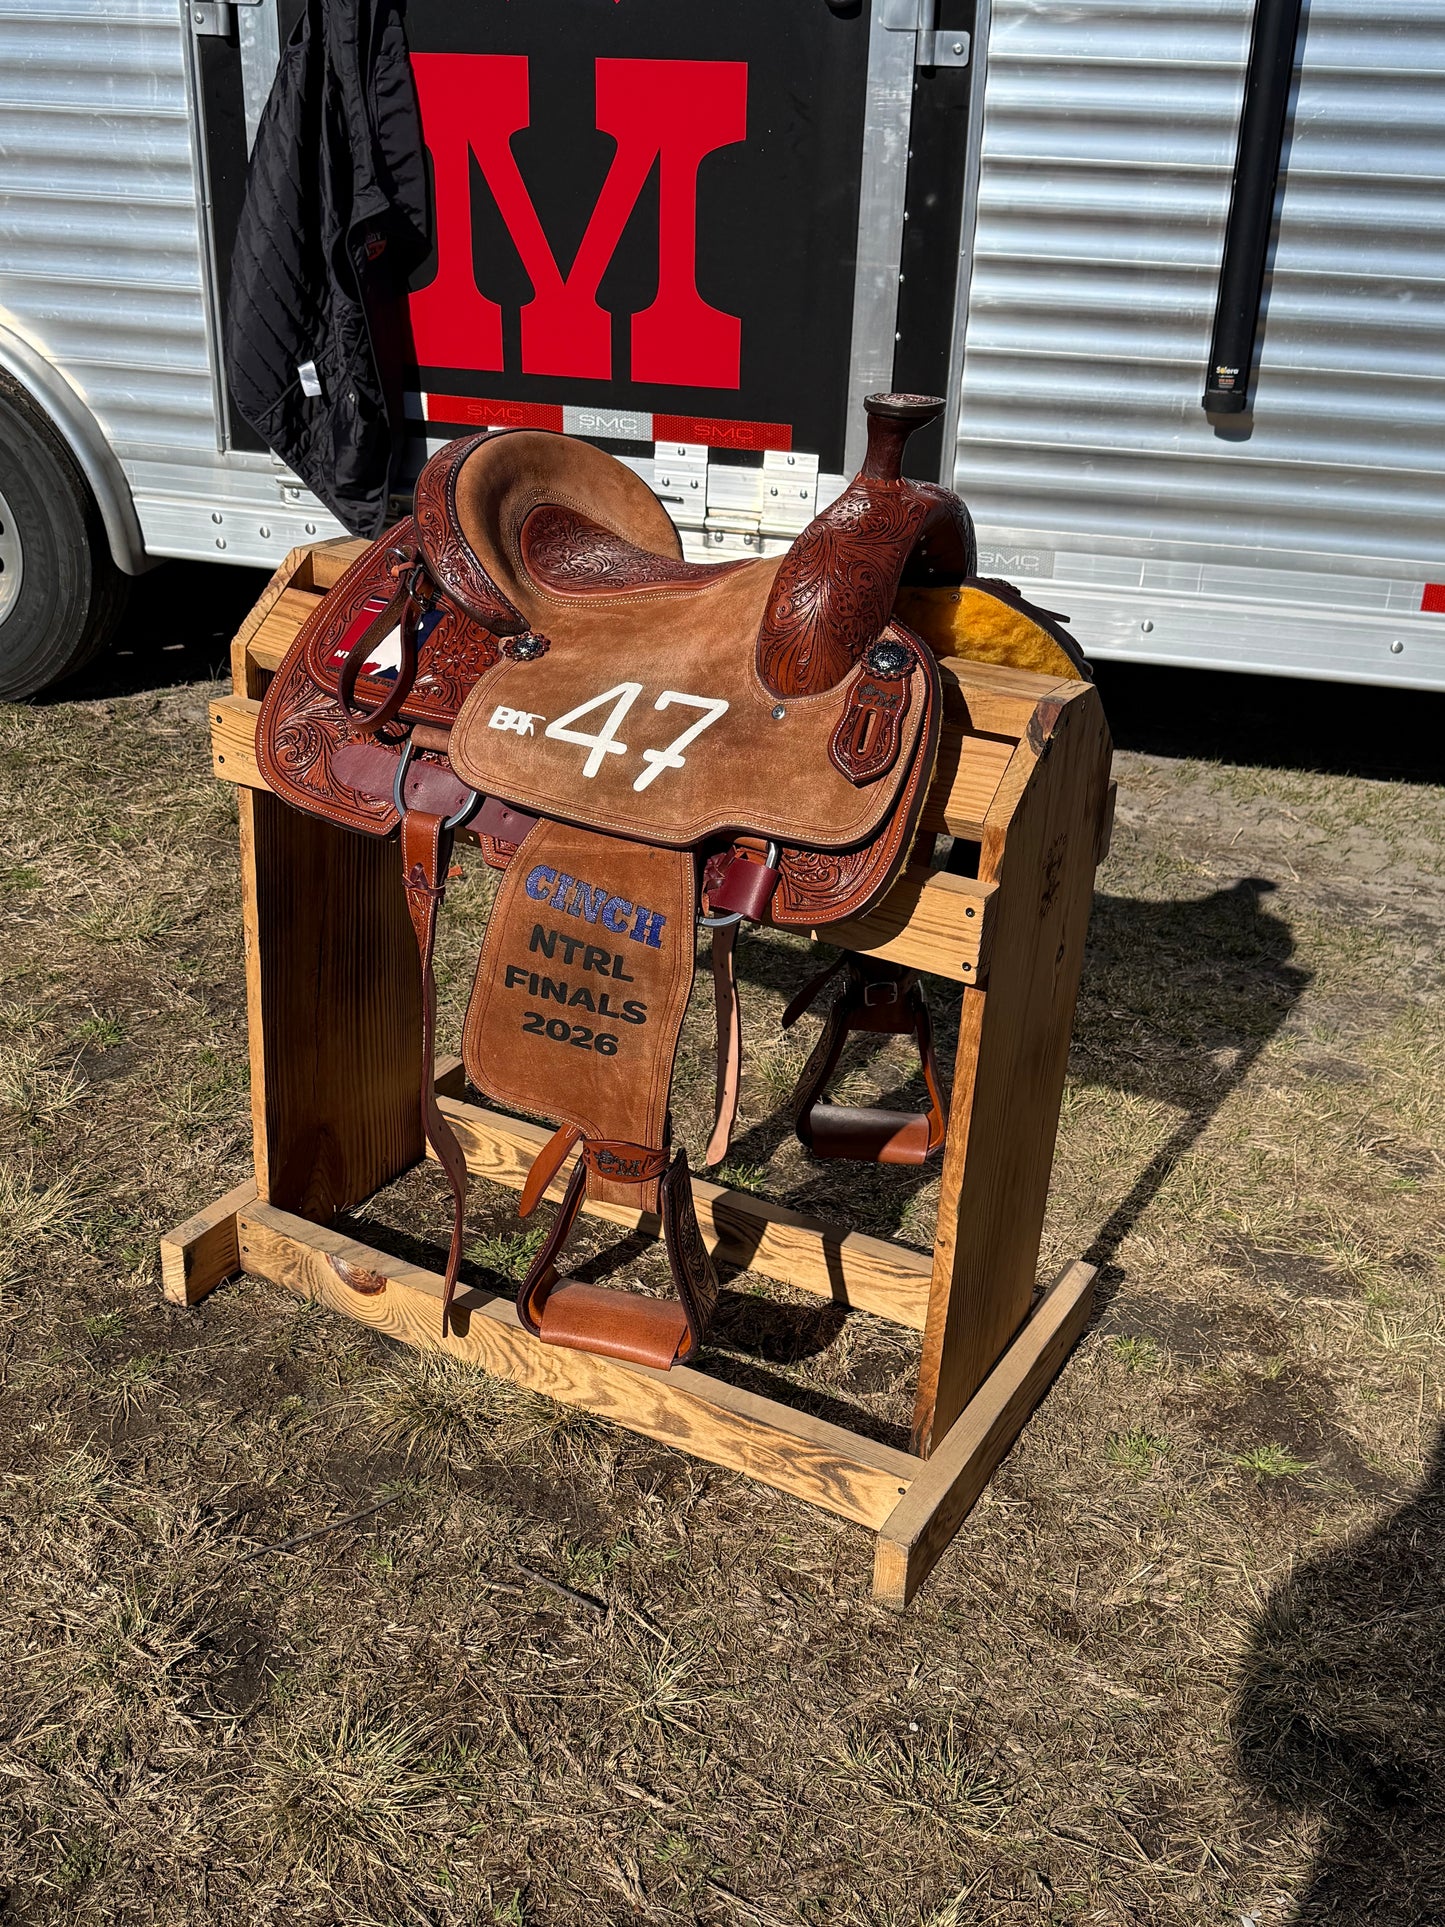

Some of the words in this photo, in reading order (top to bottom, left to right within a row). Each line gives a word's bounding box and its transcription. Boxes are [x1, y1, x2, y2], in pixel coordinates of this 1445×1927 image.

[408, 52, 748, 390] M
[467, 404, 523, 420] SMC
[579, 414, 638, 430] SMC
[694, 424, 754, 440] SMC
[977, 551, 1039, 567] SMC
[545, 681, 730, 792] 47
[525, 864, 667, 949] CINCH
[528, 923, 634, 983] NTRL
[504, 964, 648, 1025] FINALS
[522, 1011, 619, 1056] 2026
